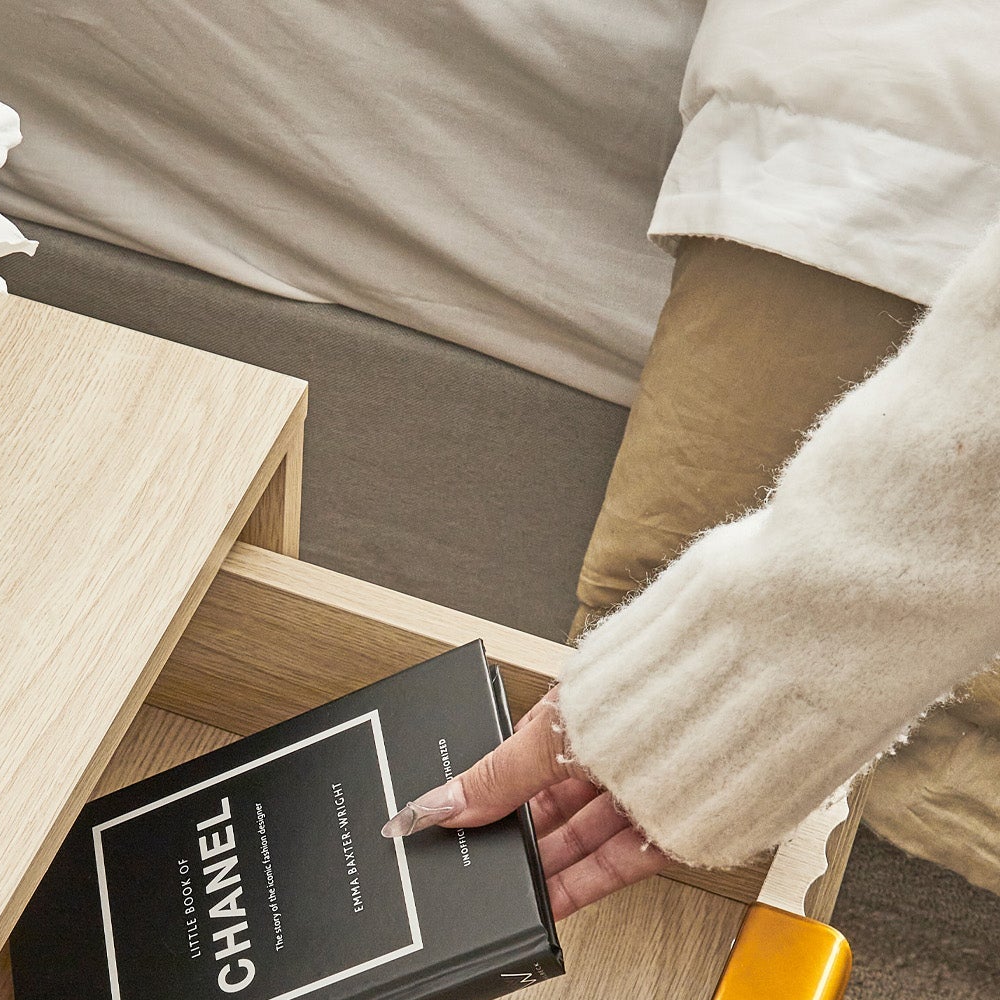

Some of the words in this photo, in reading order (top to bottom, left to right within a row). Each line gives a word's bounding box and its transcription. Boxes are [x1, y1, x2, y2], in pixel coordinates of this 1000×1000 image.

[255, 803, 266, 835] designer
[332, 783, 358, 875] BAXTER-WRIGHT
[261, 835, 271, 864] fashion
[457, 828, 471, 867] UNOFFICI
[178, 859, 189, 875] OF
[264, 863, 275, 888] iconic
[181, 878, 195, 915] BOOK
[196, 796, 256, 993] CHANEL
[268, 887, 277, 902] the
[268, 903, 279, 912] of
[350, 877, 364, 913] EMMA
[187, 917, 201, 958] LITTLE
[273, 913, 282, 934] story
[275, 934, 285, 952] The
